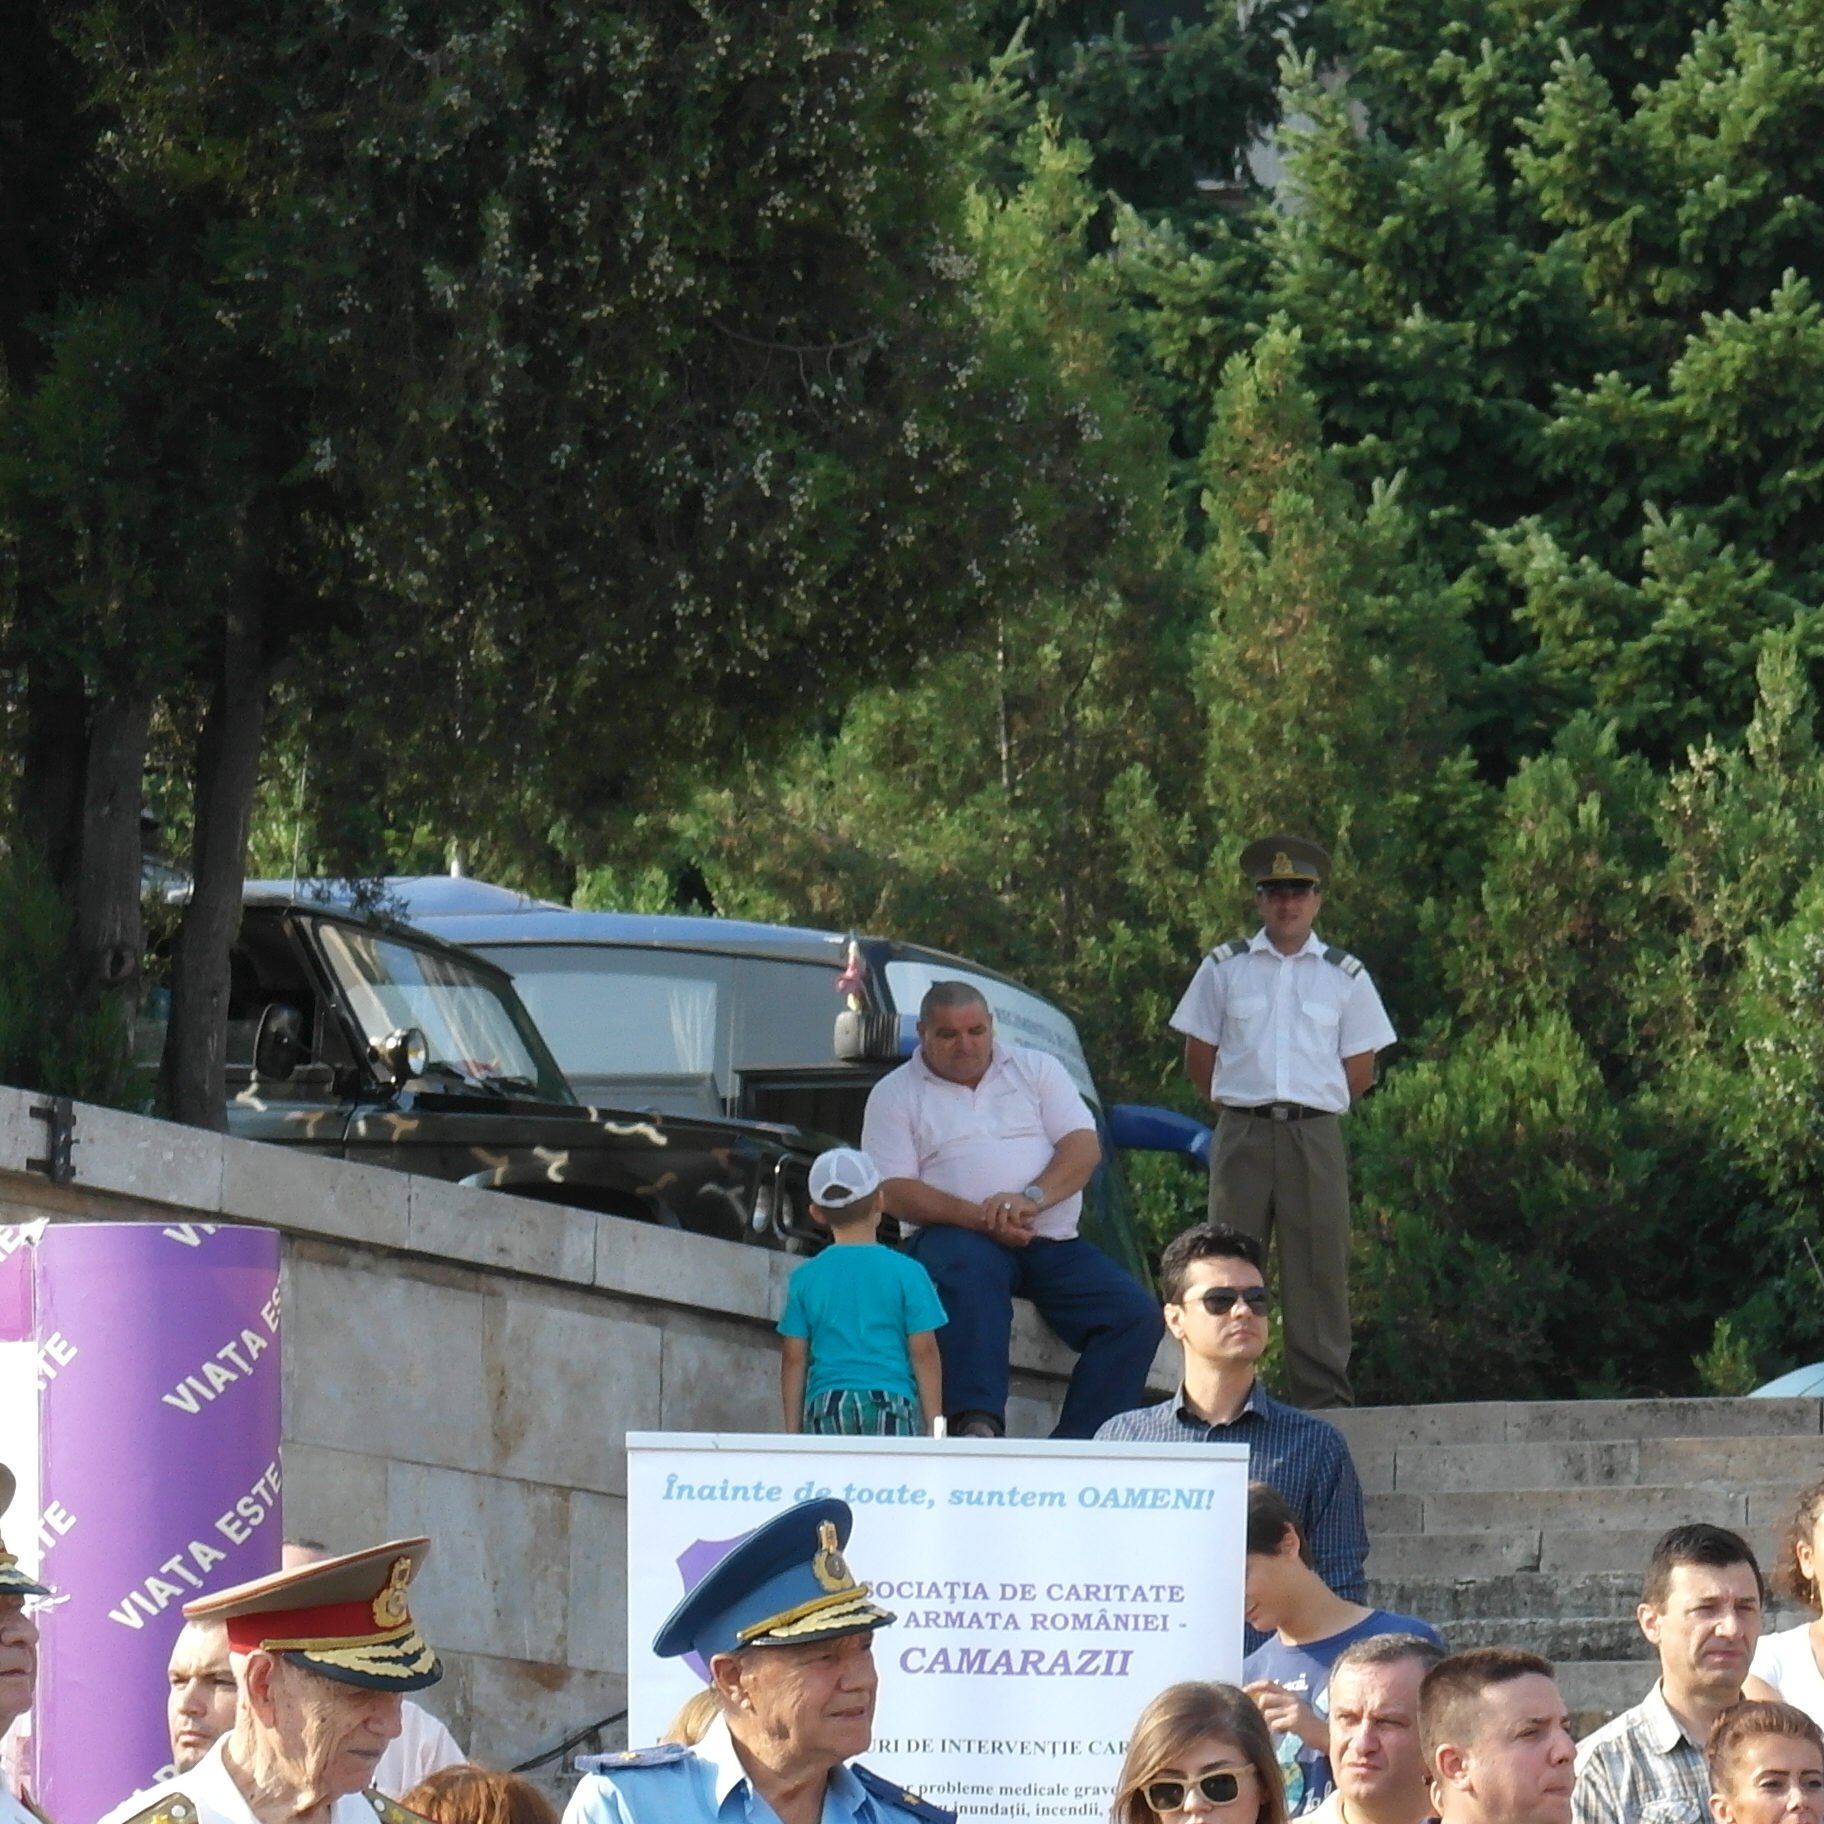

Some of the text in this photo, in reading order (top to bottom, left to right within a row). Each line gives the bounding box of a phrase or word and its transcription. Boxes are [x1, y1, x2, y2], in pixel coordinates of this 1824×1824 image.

[662, 1473, 1216, 1511] Înainte de toate, suntem OAMENI!
[999, 1583, 1037, 1602] DE
[1046, 1584, 1186, 1603] CARITATE
[903, 1611, 1022, 1631] ARMATA
[1030, 1609, 1170, 1632] ROMÂNIEI
[899, 1647, 1135, 1677] CAMARAZII
[907, 1739, 934, 1754] DE
[941, 1739, 1082, 1758] INTERVENȚIE
[919, 1781, 994, 1798] probleme
[999, 1782, 1069, 1797] medicale
[1036, 1803, 1103, 1817] incendii,
